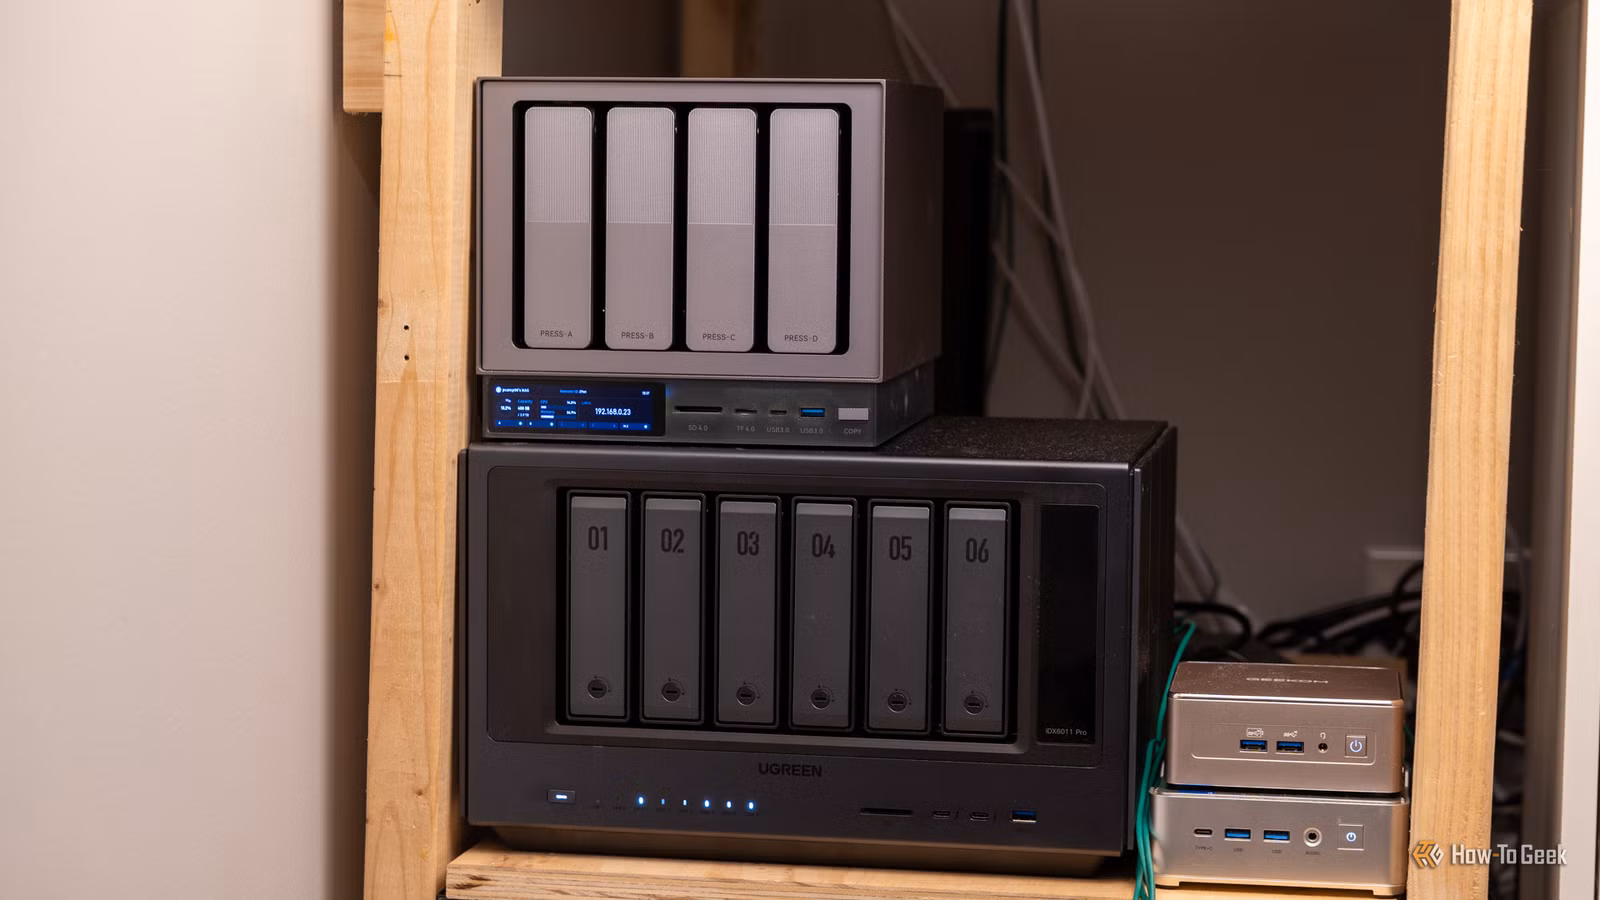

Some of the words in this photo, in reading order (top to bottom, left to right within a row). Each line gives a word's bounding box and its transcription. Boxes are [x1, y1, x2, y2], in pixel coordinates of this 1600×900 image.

[540, 330, 573, 338] PRESS-A
[702, 333, 736, 341] PRESS-C
[784, 334, 819, 342] PRESS-D
[595, 407, 632, 415] 192.168.0.23
[588, 526, 608, 551] 01
[661, 528, 685, 553] 02
[737, 531, 760, 556] 03
[811, 533, 836, 559] 04
[889, 535, 912, 561] 05
[965, 537, 989, 563] 06
[1075, 728, 1088, 736] Pro
[758, 762, 822, 778] UGREEN
